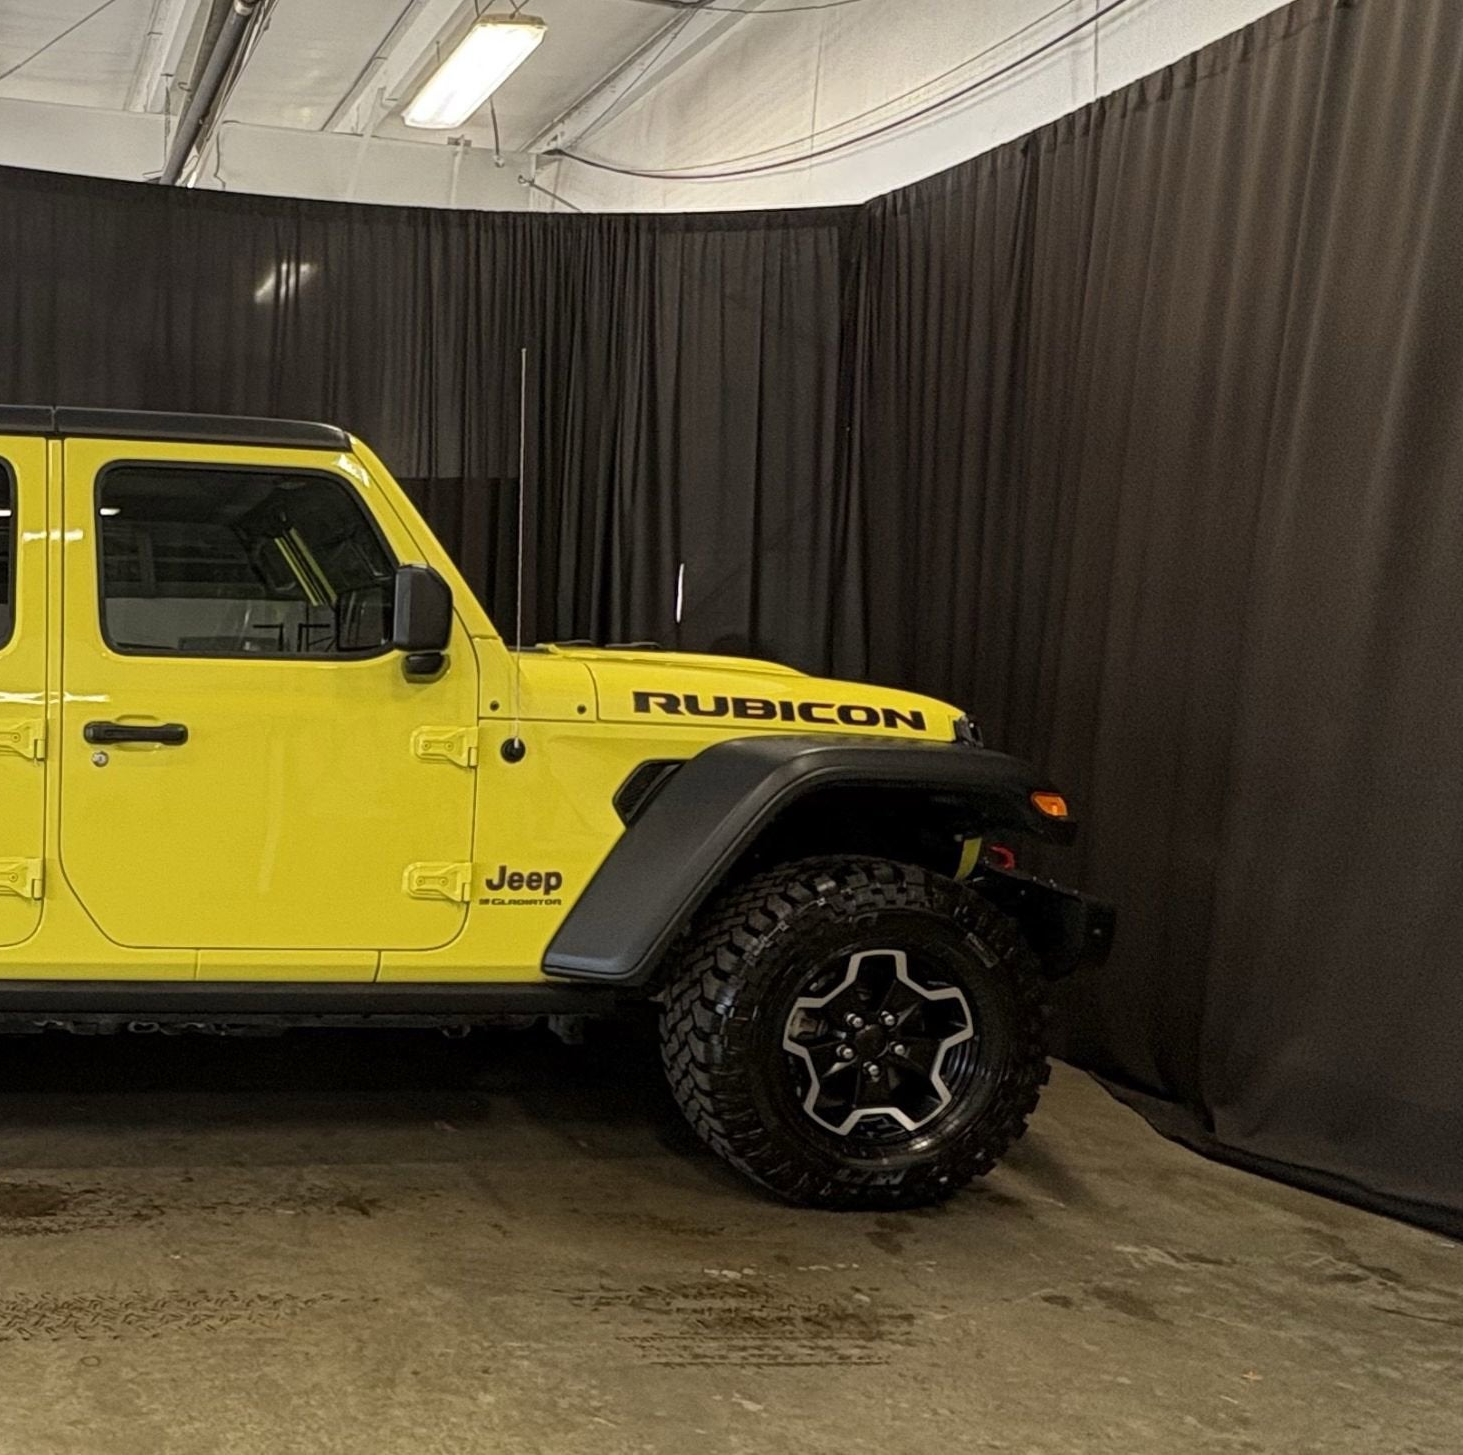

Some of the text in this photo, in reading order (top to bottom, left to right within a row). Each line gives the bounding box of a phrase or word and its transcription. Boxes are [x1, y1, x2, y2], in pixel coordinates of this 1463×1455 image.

[632, 691, 927, 731] RUBICON
[485, 865, 562, 896] Jeep
[491, 898, 562, 906] GLADIATOR
